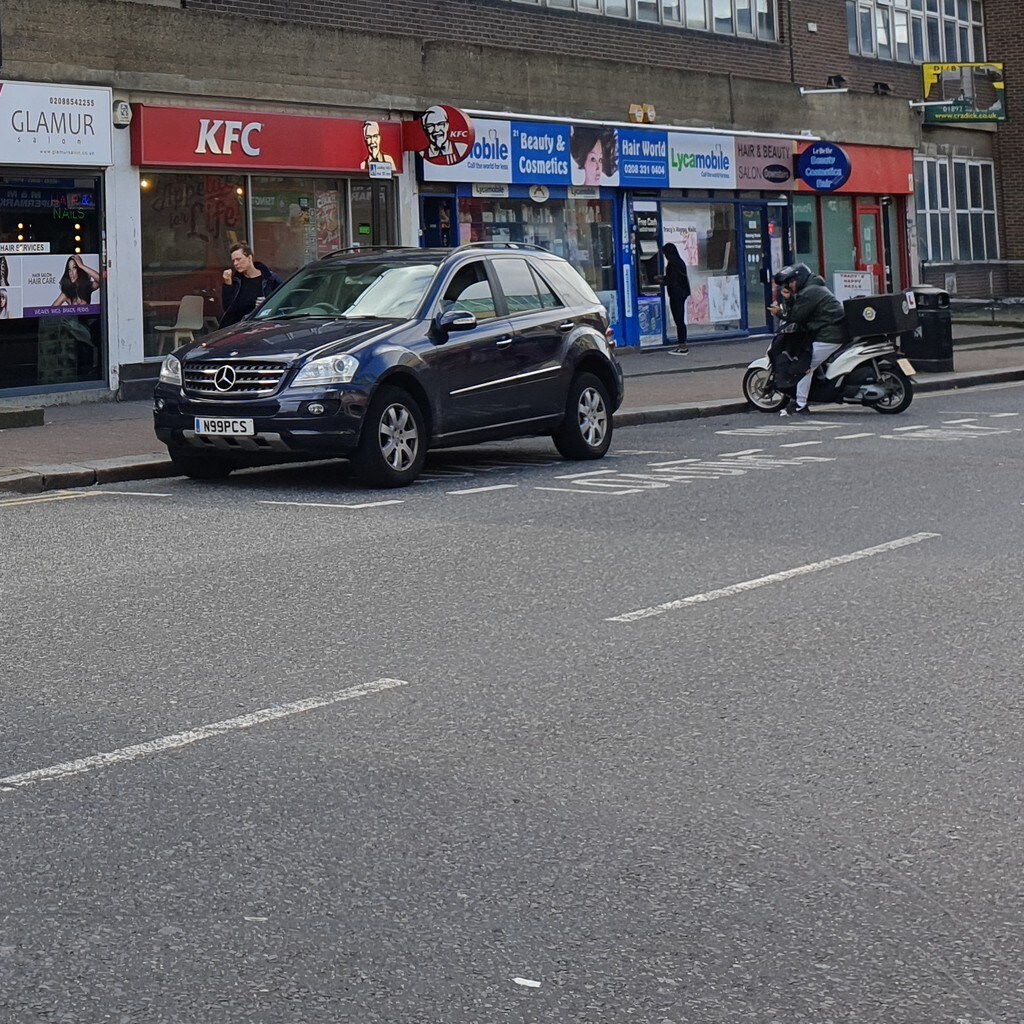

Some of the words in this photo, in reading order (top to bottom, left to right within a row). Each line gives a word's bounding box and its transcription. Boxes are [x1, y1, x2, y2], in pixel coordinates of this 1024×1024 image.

[49, 96, 95, 107] 02088542255
[11, 109, 95, 136] GLAMUR
[195, 118, 262, 156] KFC
[450, 130, 468, 138] KFC
[469, 137, 508, 161] obile
[520, 132, 554, 155] Beauty
[556, 135, 566, 152] &
[622, 140, 640, 156] Hair
[642, 140, 666, 158] World
[737, 144, 755, 157] HAIR
[756, 146, 762, 157] &
[763, 146, 790, 159] BEAUTY
[519, 156, 568, 175] Cosmetics
[671, 148, 730, 171] Lycamobile
[810, 156, 836, 165] Beauty
[624, 163, 638, 174] 0208
[640, 165, 650, 174] 331
[651, 166, 665, 175] 0404
[738, 166, 761, 180] SALON
[805, 167, 842, 177] Cosmetics
[816, 178, 832, 188] Hair
[53, 207, 85, 219] NAILS
[637, 217, 646, 226] Free
[647, 217, 657, 226] Cash
[28, 277, 41, 285] HAIR
[42, 277, 56, 285] CARE
[908, 295, 914, 305] L
[203, 419, 248, 433] N99PCS
